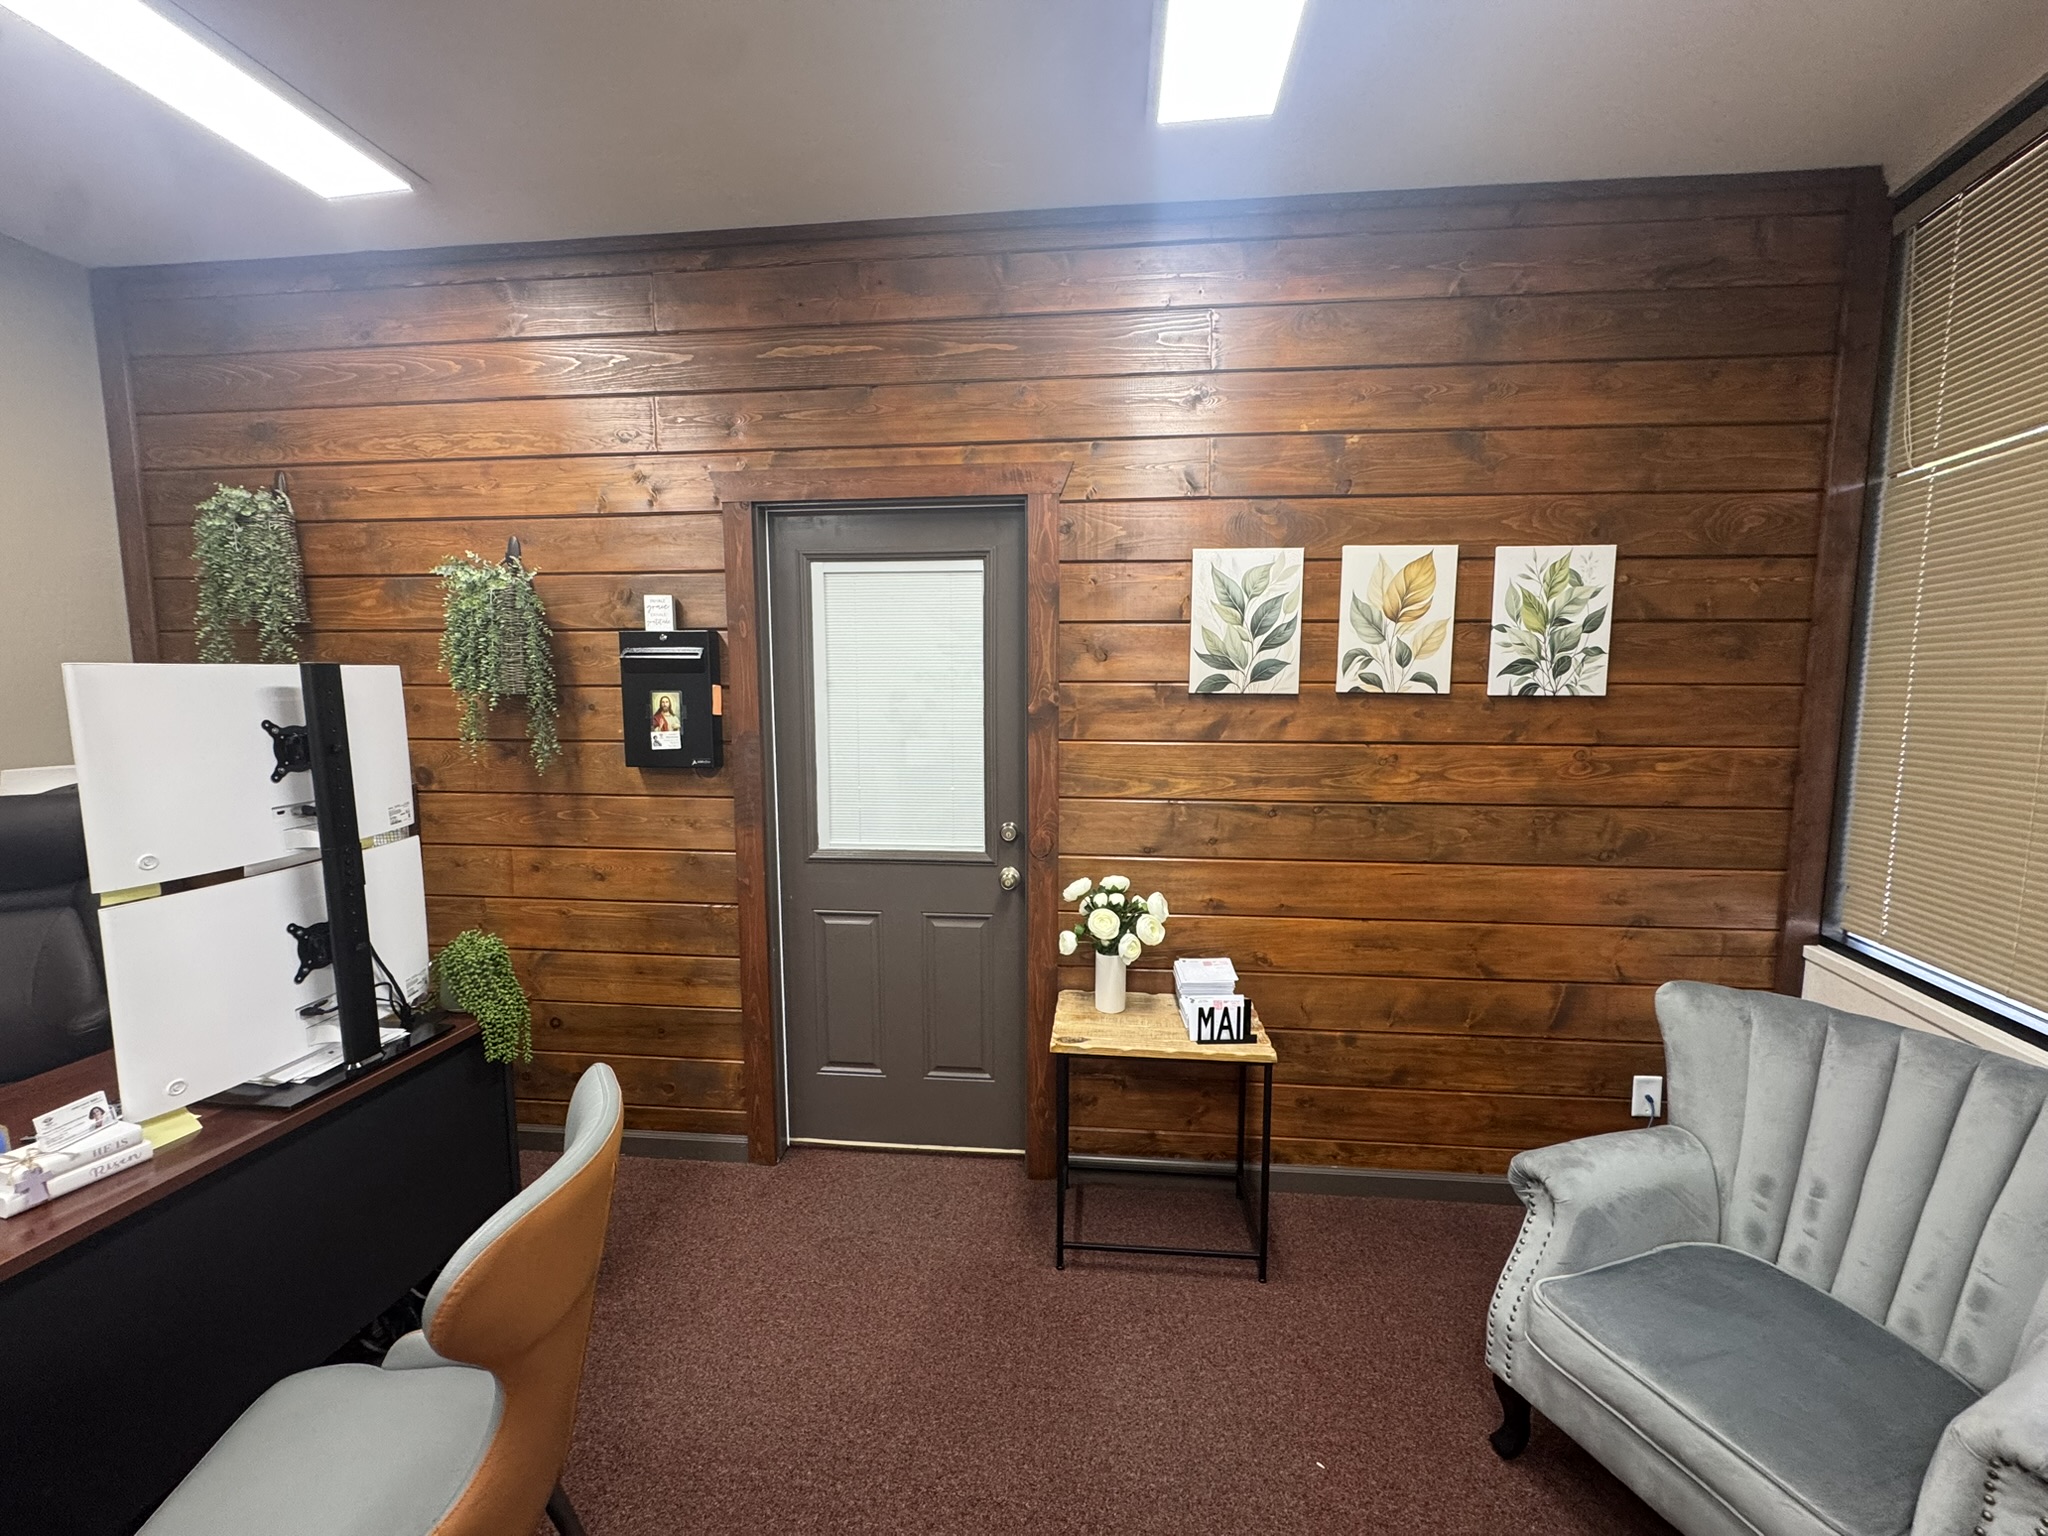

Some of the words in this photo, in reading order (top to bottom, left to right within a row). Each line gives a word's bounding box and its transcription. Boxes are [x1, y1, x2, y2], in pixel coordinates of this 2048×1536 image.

[1197, 998, 1258, 1044] MAIL
[92, 1143, 112, 1158] HE
[116, 1137, 129, 1149] IS
[88, 1151, 143, 1178] Risen
